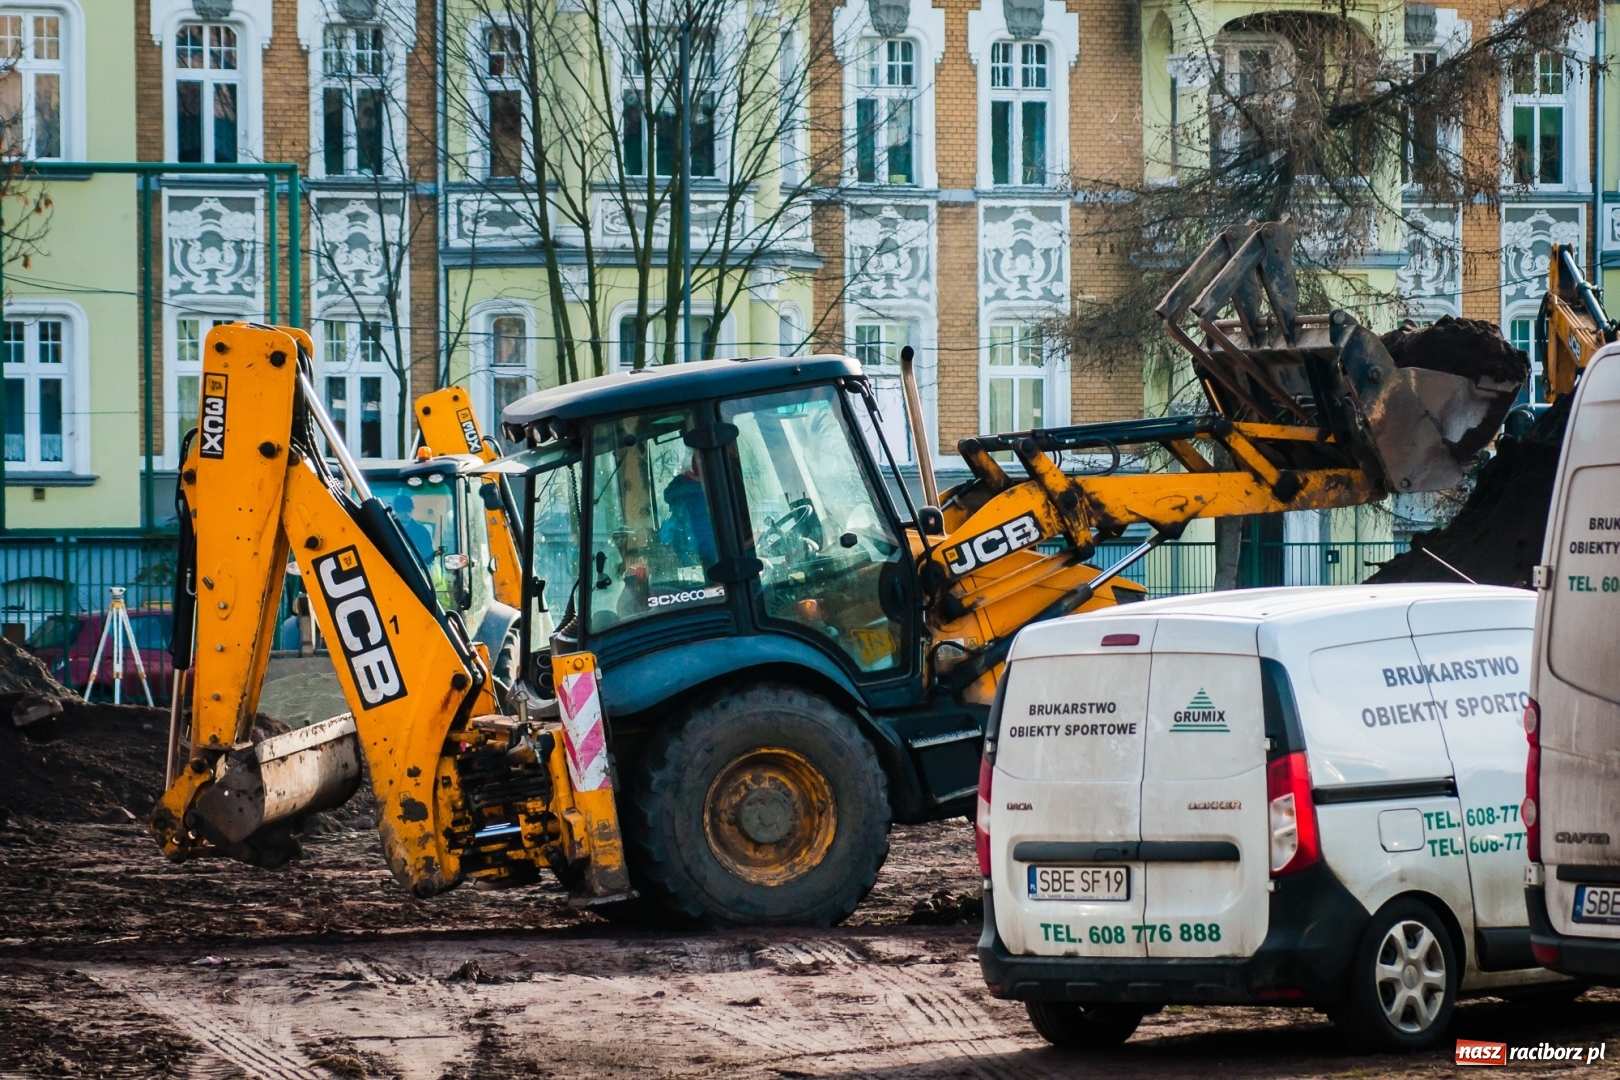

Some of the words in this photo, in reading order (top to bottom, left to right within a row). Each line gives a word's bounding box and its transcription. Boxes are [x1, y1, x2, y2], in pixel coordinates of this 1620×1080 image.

[201, 397, 224, 451] 3CX
[461, 420, 482, 451] 3CX
[950, 515, 1040, 575] JCB
[1569, 541, 1620, 554] OBIEKTY
[1568, 575, 1597, 592] TEL.
[1602, 576, 1620, 592] 60
[319, 557, 400, 704] JCB
[389, 615, 400, 635] 1
[1382, 655, 1520, 688] BRUKARSTWO
[1029, 702, 1117, 716] BRUKARSTWO
[1173, 710, 1226, 723] GRUMIX
[1361, 699, 1449, 728] OBIEKTY
[1009, 724, 1061, 738] OBIEKTY
[1064, 723, 1137, 736] SPORTOWE
[1006, 802, 1033, 811] DACIA
[1188, 801, 1242, 810] DOKKER
[1423, 811, 1461, 831] TEL.
[1427, 838, 1464, 857] TEL.
[1469, 832, 1528, 854] 608-77
[1555, 831, 1611, 845] CRAFTER
[1039, 870, 1075, 893] SBE
[1081, 870, 1124, 893] SF19
[1585, 890, 1620, 916] SBE
[1040, 922, 1083, 943] TEL.
[1088, 925, 1126, 944] 608
[1131, 923, 1173, 944] 776
[1179, 923, 1222, 943] 888
